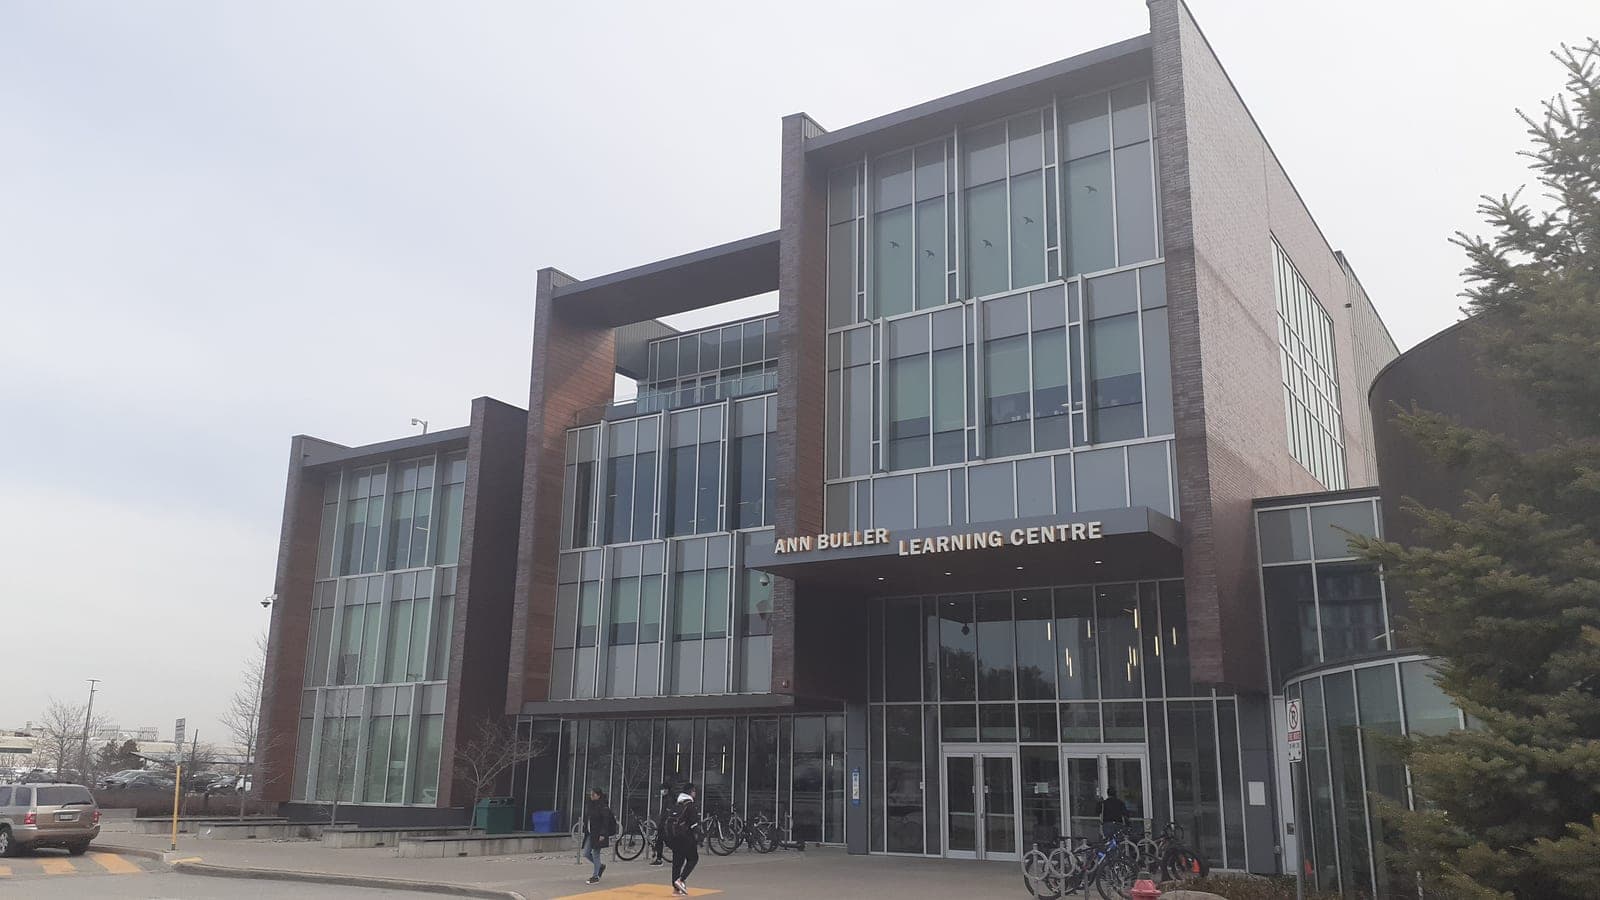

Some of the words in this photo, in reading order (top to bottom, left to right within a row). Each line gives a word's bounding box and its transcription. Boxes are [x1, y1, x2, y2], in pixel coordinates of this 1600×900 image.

[774, 535, 811, 554] ANN
[817, 527, 889, 550] BULLER
[898, 530, 1002, 556] LEARNING
[1010, 521, 1102, 546] CENTRE
